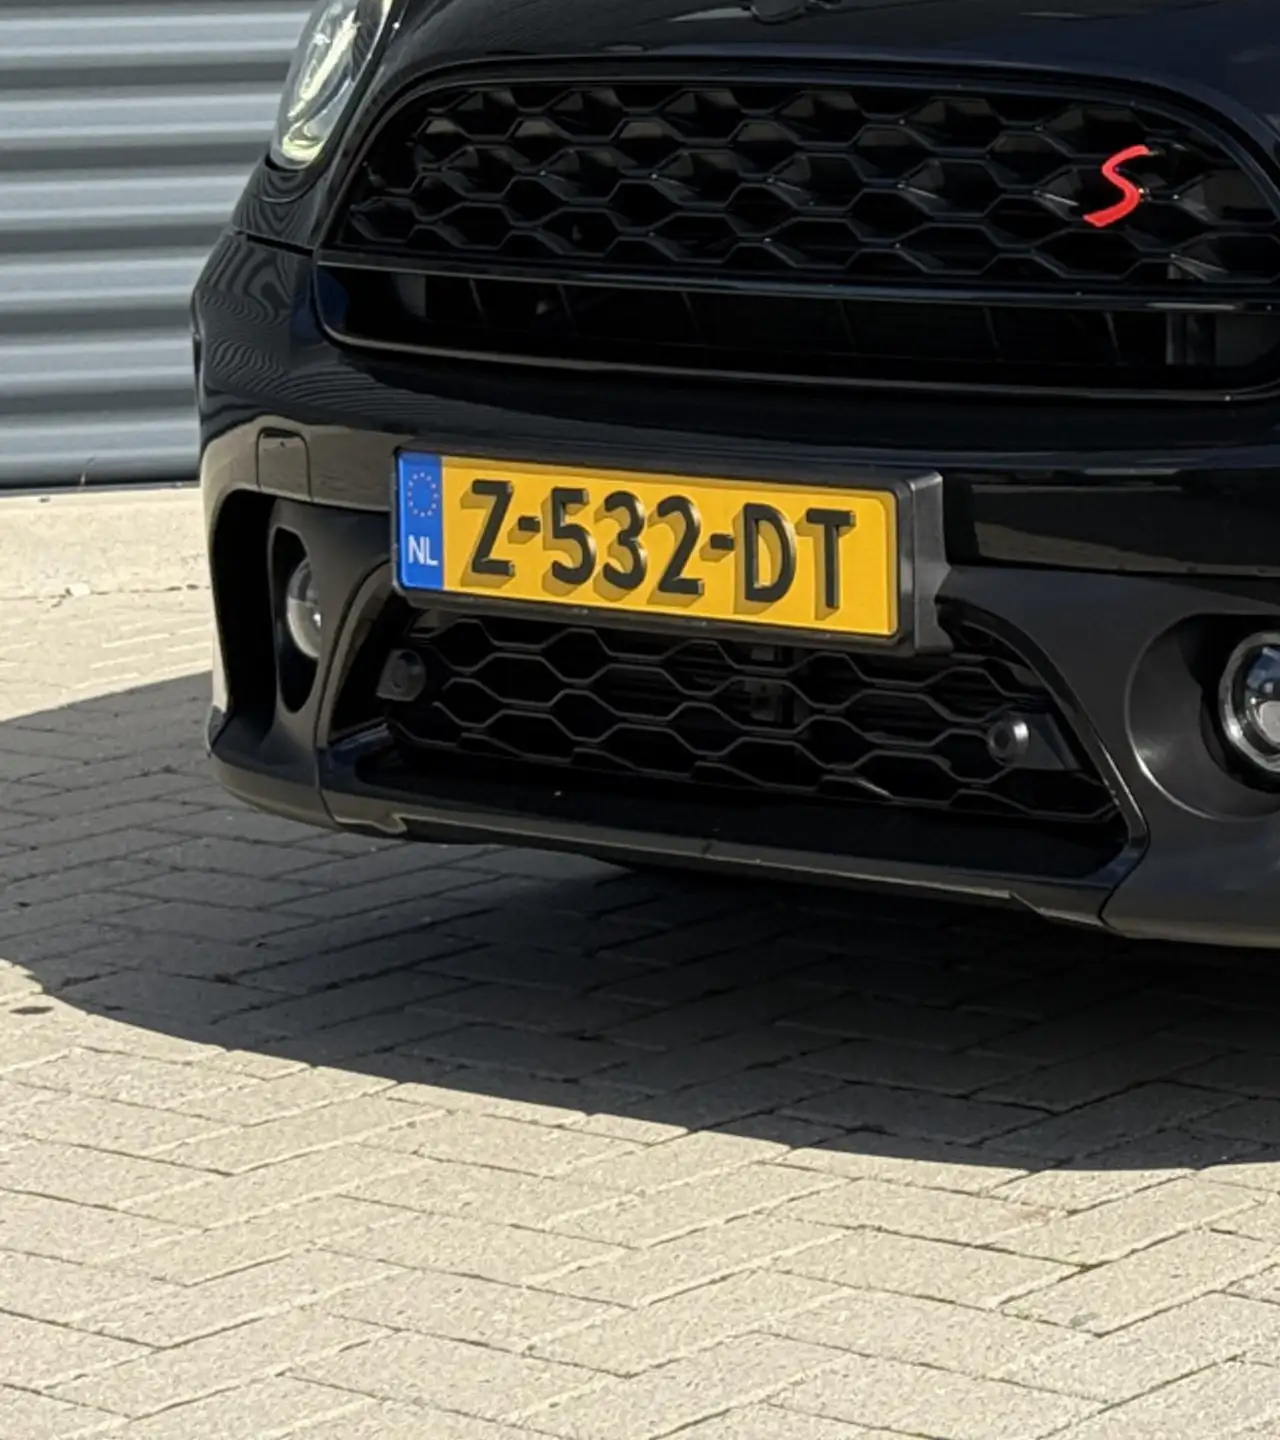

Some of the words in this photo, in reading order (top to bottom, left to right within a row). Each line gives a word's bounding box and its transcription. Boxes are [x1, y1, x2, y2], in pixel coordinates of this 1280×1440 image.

[1083, 144, 1149, 228] S
[408, 535, 439, 566] NL
[471, 479, 856, 609] Z-532-DT
